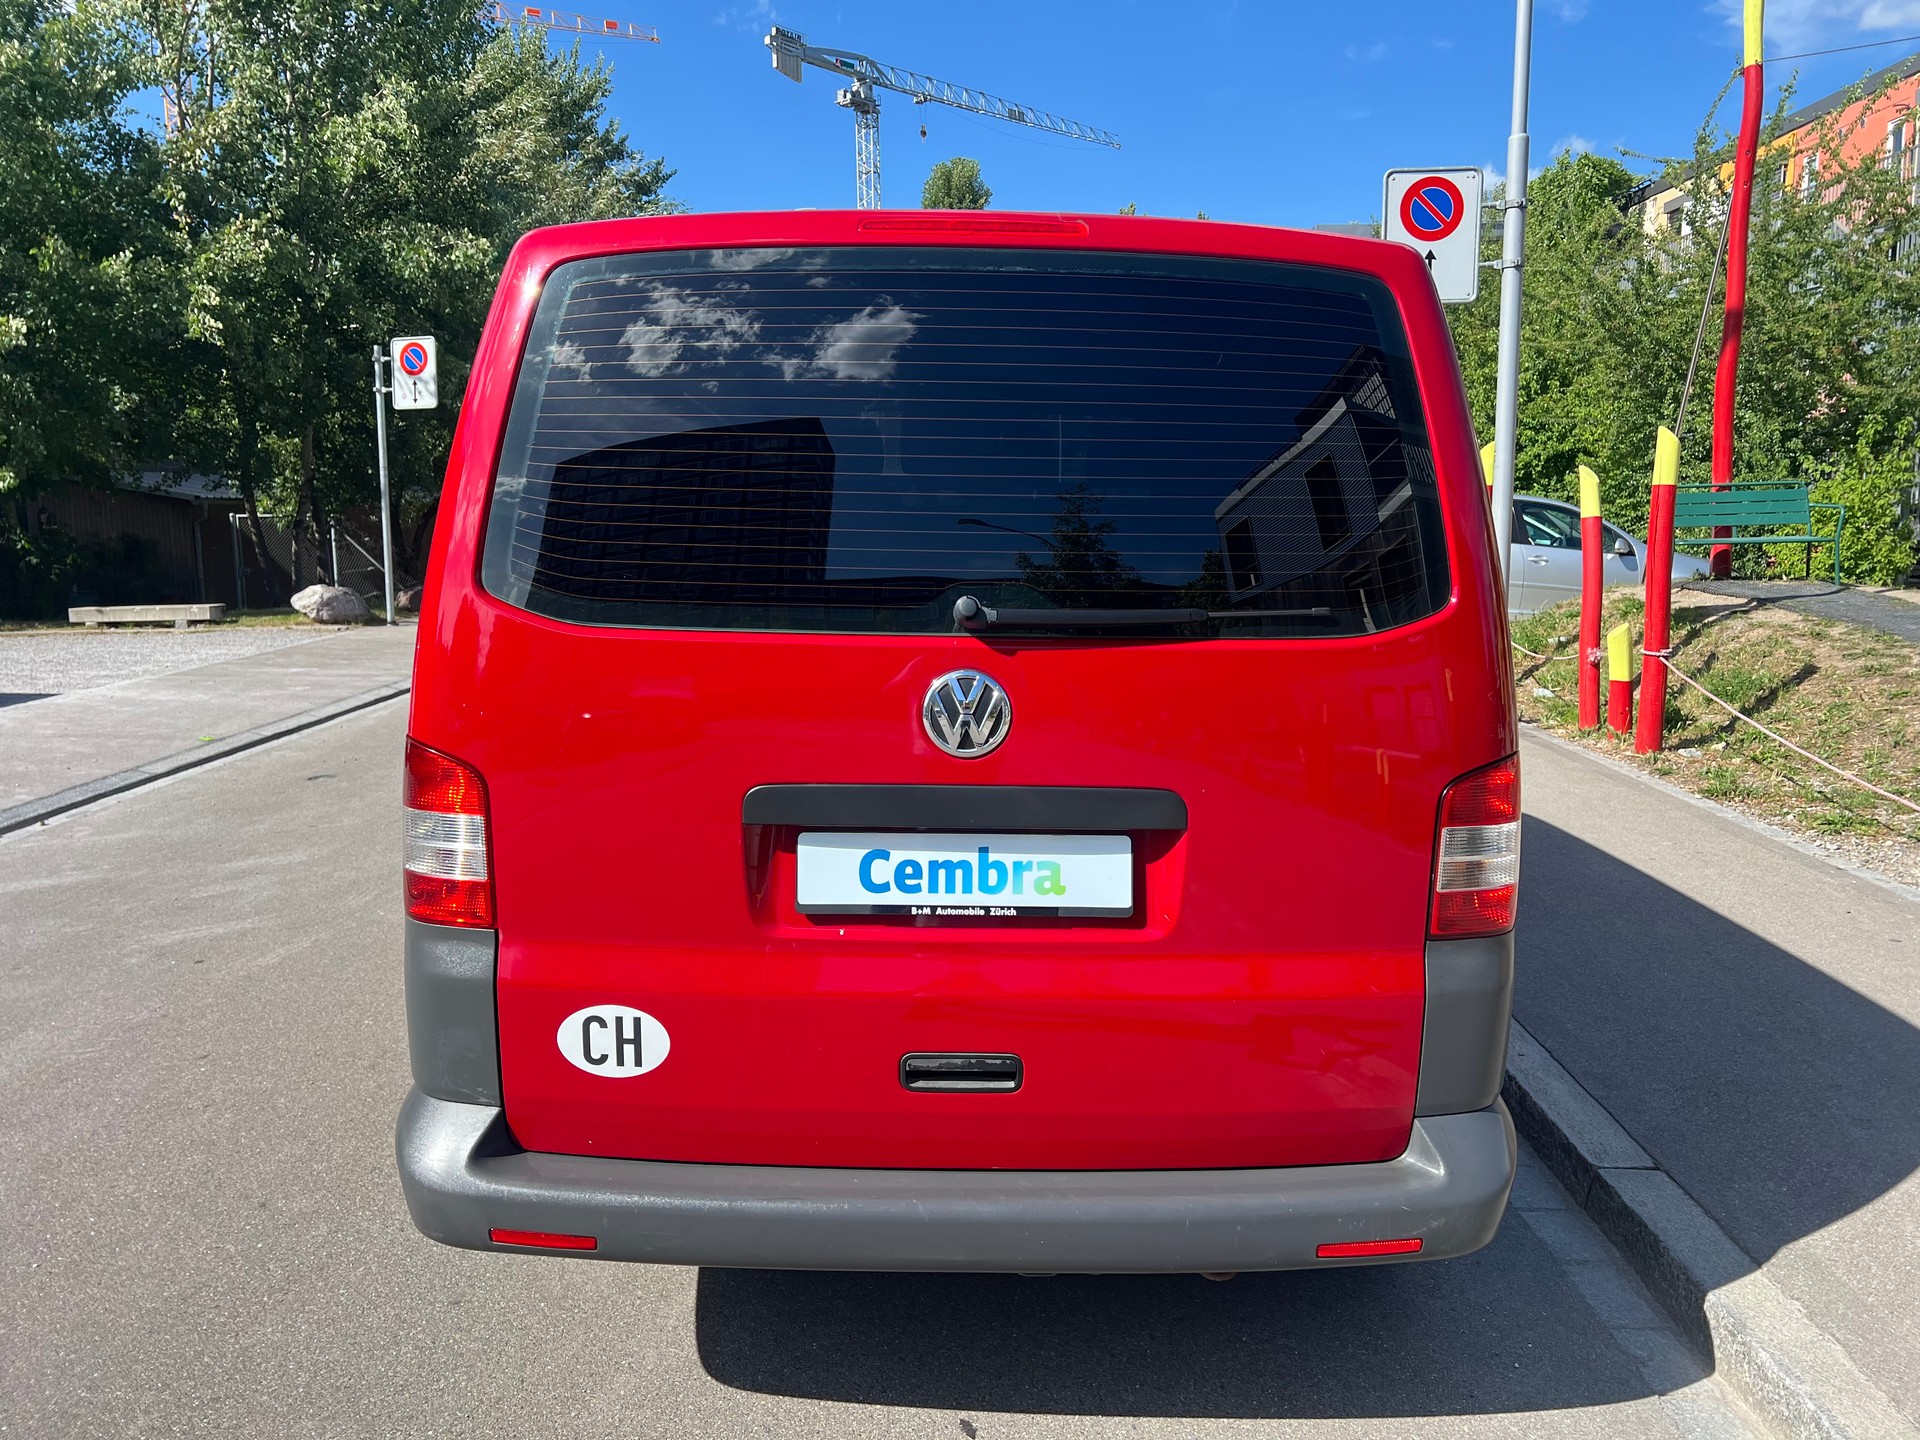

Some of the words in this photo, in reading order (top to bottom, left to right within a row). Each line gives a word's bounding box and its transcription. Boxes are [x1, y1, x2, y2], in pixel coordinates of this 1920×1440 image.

[925, 671, 1008, 755] VW
[858, 846, 1067, 896] Cembra
[911, 906, 931, 915] B+M
[935, 906, 985, 916] Automobile
[989, 907, 1017, 916] Zürich
[582, 1015, 643, 1068] CH
